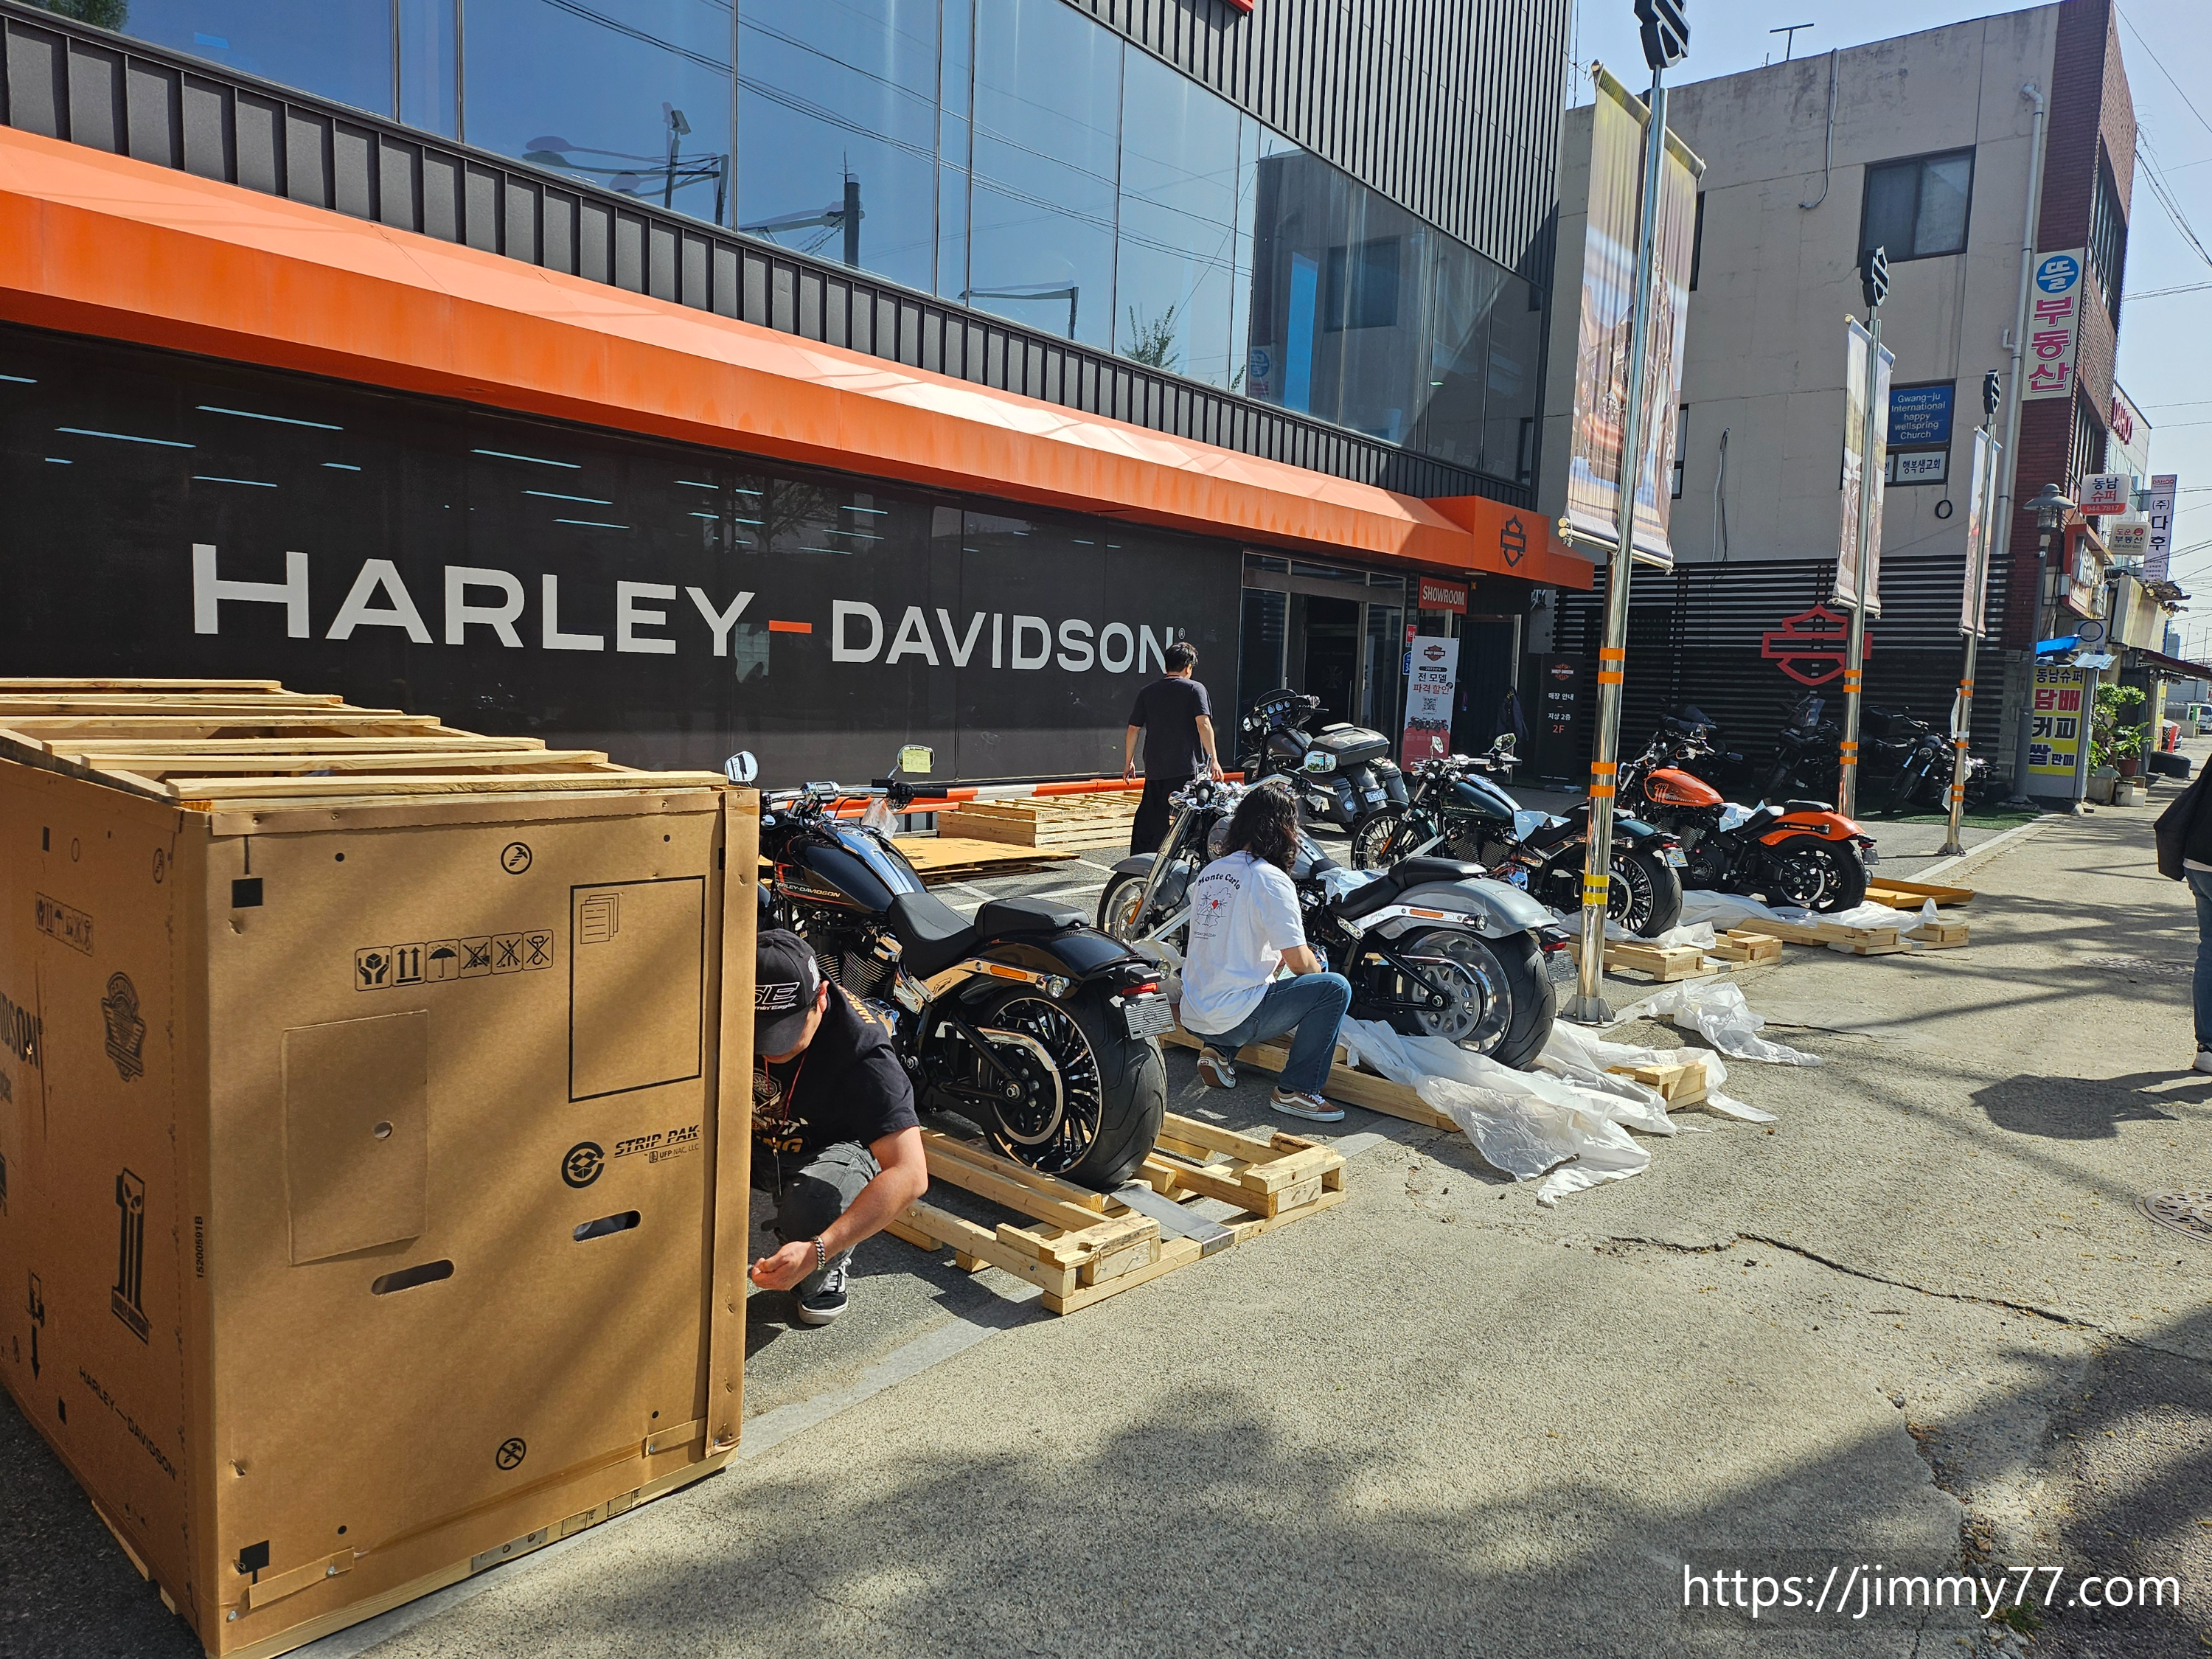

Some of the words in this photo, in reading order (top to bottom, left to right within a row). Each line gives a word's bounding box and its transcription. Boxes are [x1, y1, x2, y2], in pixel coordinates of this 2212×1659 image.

[2038, 260, 2075, 291] 뜰
[2028, 296, 2073, 392] 부동산
[1897, 392, 1941, 403] Gwang-ju
[1891, 401, 1946, 412] International
[1904, 412, 1930, 422] happy
[1894, 421, 1939, 431] wellspring
[1900, 431, 1931, 439] Church
[1902, 459, 1941, 474] 행복샘교회
[2092, 477, 2119, 490] 동남
[2090, 490, 2117, 502] 슈퍼
[2149, 515, 2168, 551] 다후
[2115, 536, 2143, 544] 부동산
[1422, 585, 1465, 606] SHOWROOM
[1418, 672, 1427, 682] 전
[1429, 673, 1447, 684] 모델
[2037, 668, 2084, 684] 동남슈퍼
[1413, 684, 1431, 694] 파격
[1433, 684, 1450, 695] 할인
[1548, 692, 1561, 700] 매장
[2034, 689, 2081, 712] 담배
[1548, 712, 1560, 720] 지상
[1560, 713, 1572, 721] 2층
[1552, 724, 1565, 734] 2F
[2031, 716, 2078, 739] 커피
[2028, 743, 2052, 766] 쌀
[2051, 754, 2075, 766] 판매
[1197, 872, 1224, 886] Monte
[1225, 873, 1240, 890] Carlo
[614, 1133, 662, 1156] STRIP
[667, 1124, 700, 1144] PAK
[659, 1150, 672, 1158] UFP
[688, 1144, 699, 1152] LLC
[194, 1216, 204, 1279] 15200591B
